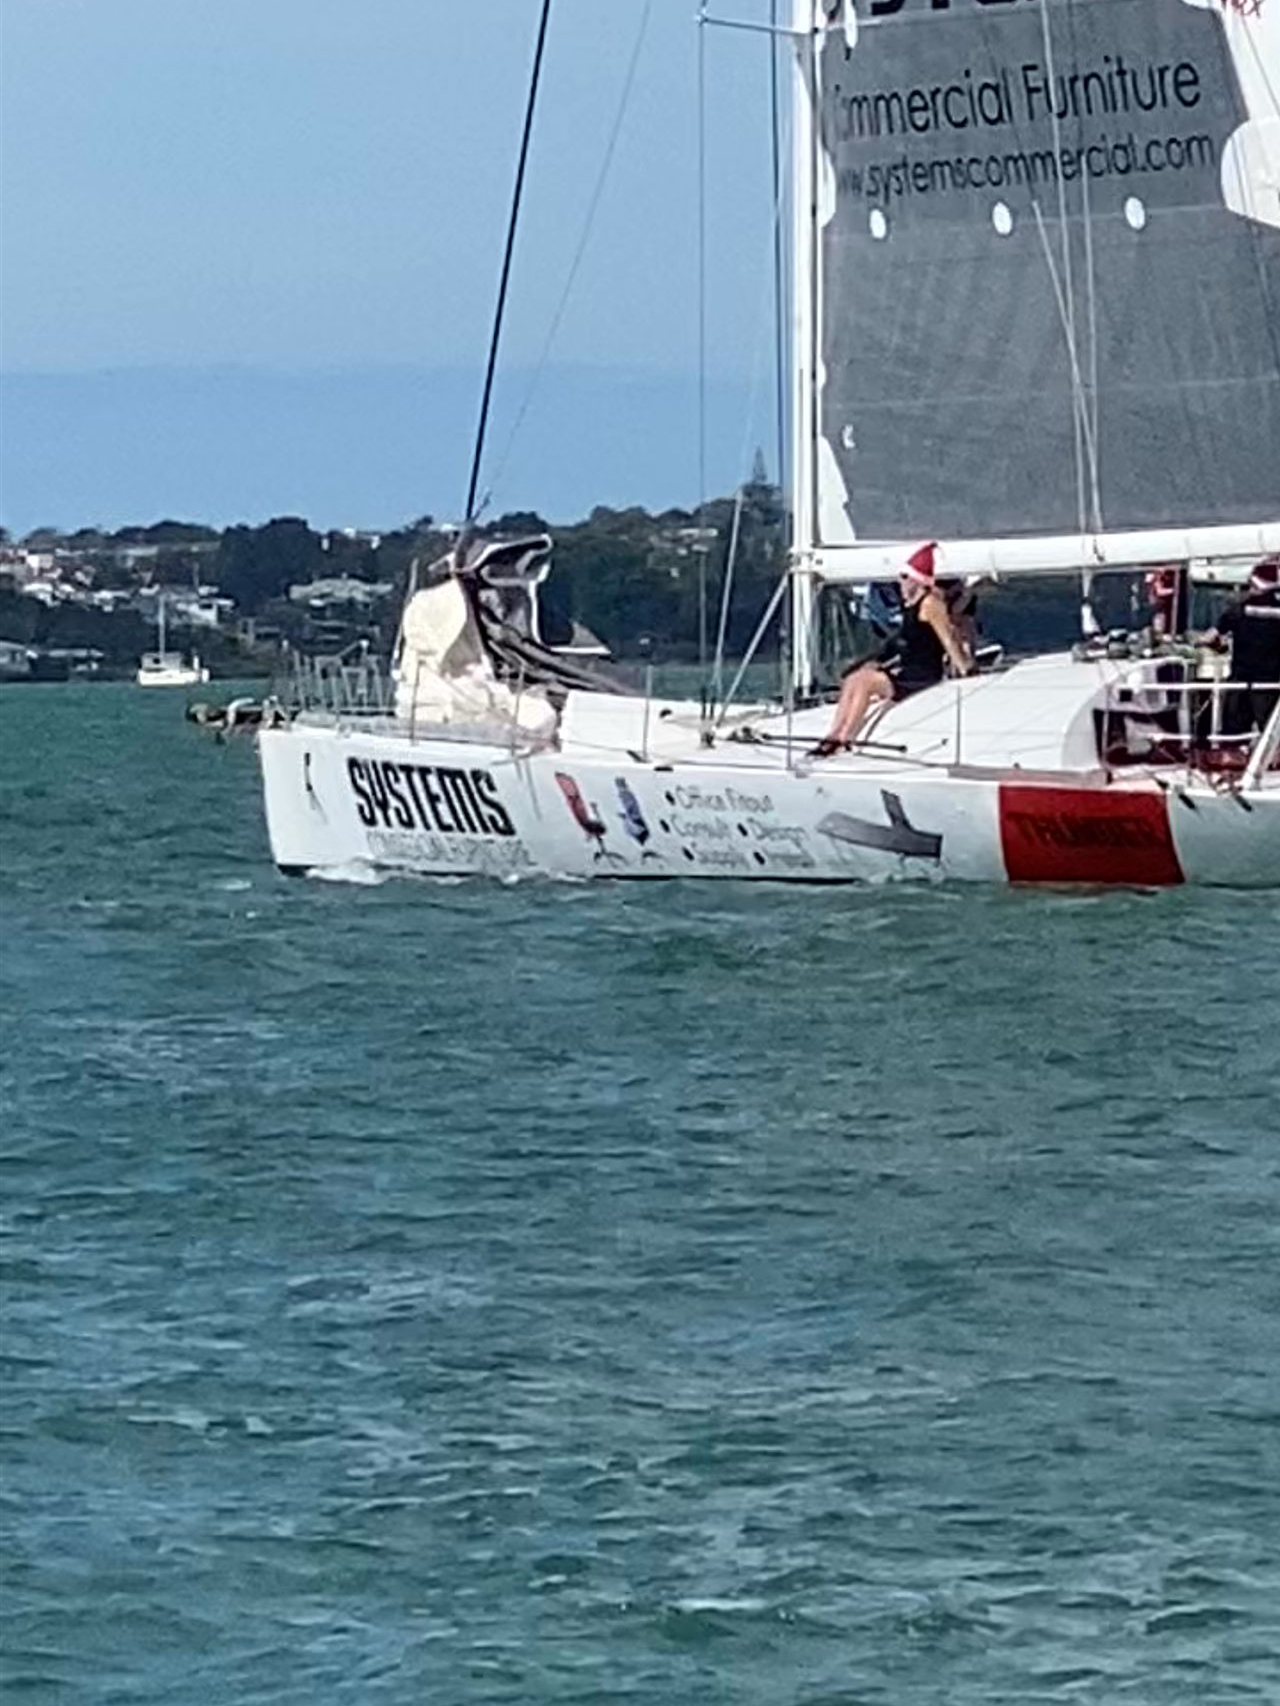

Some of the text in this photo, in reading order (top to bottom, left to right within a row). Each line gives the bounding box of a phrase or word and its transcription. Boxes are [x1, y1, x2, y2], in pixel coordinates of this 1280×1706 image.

[834, 55, 1200, 140] mmercial Furniture
[347, 757, 516, 836] SYSTEMS
